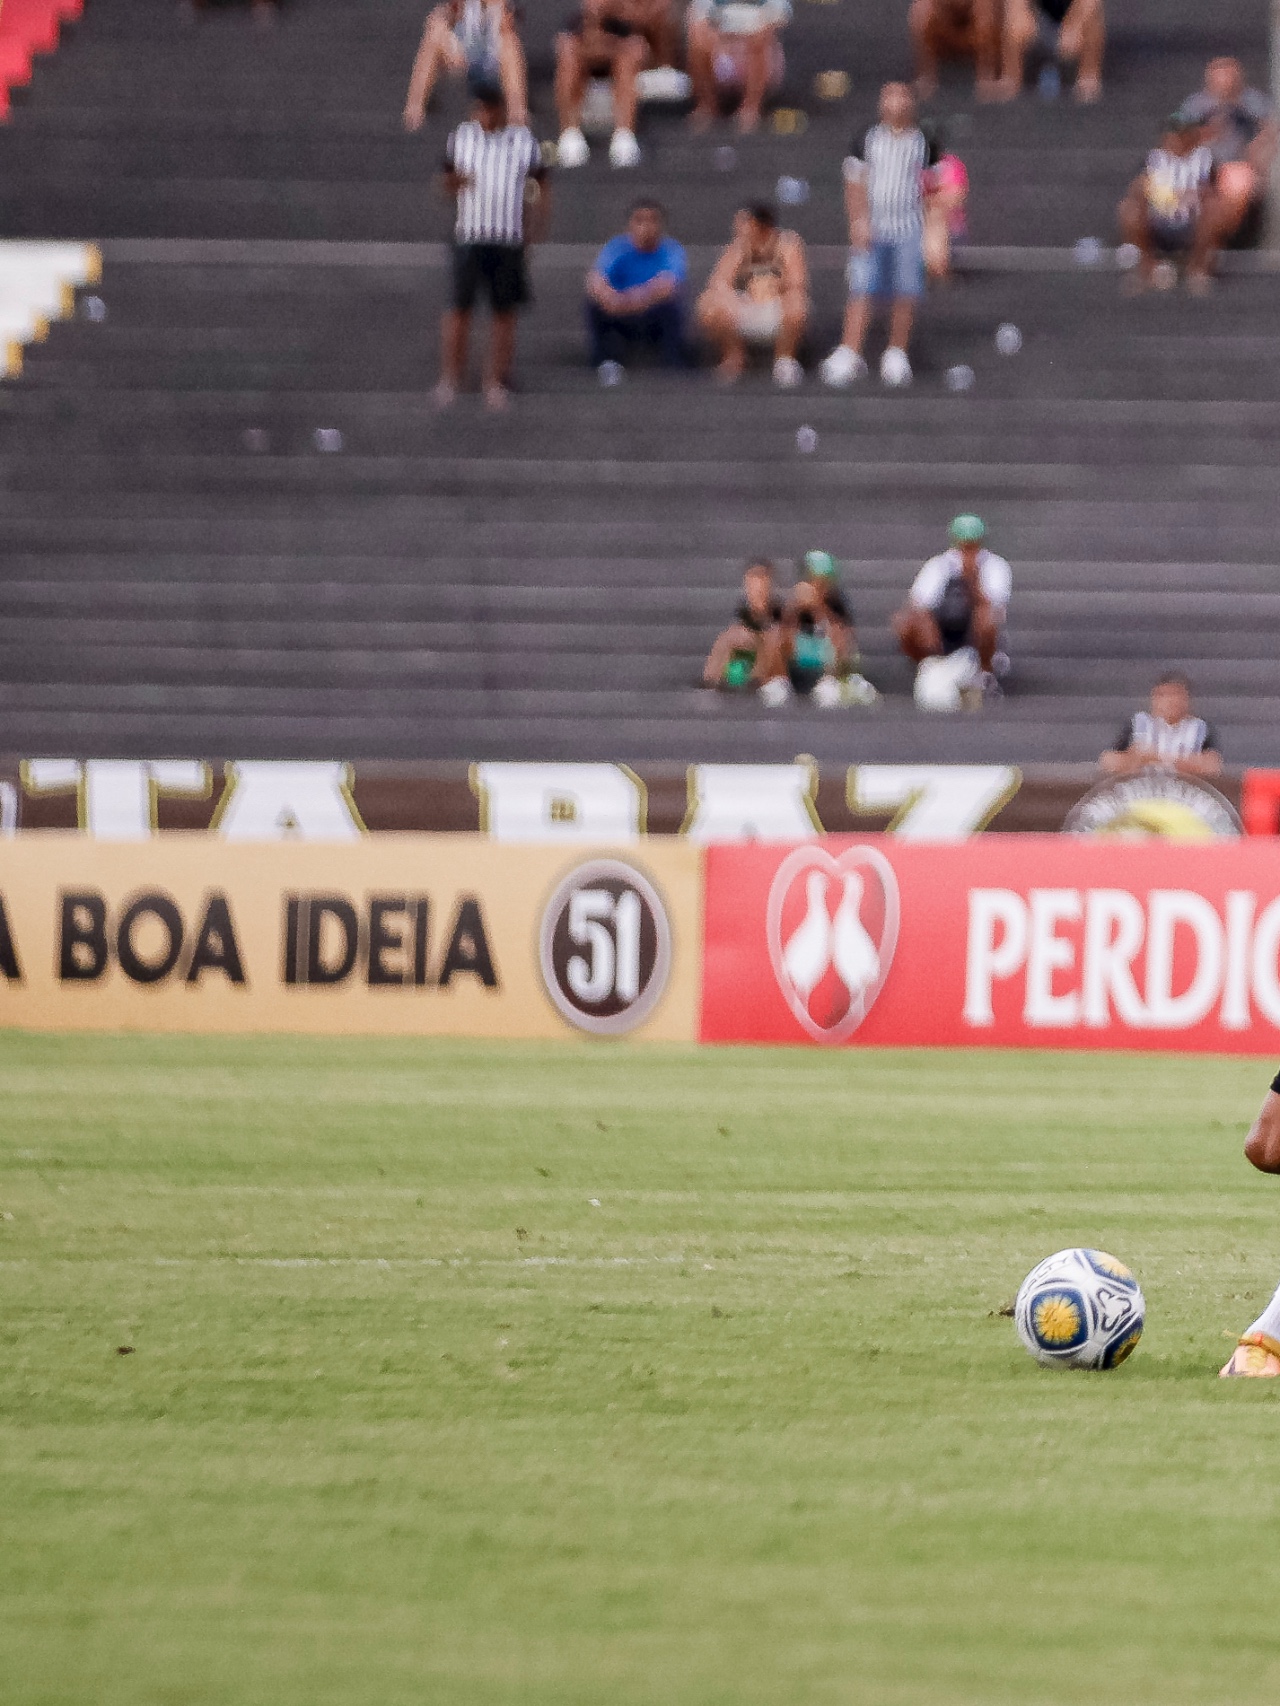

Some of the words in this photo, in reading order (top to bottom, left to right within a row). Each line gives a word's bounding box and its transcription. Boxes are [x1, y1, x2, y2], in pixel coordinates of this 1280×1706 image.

[58, 890, 248, 985] BOA
[282, 890, 499, 988] IDEIA
[566, 889, 642, 1003] 51
